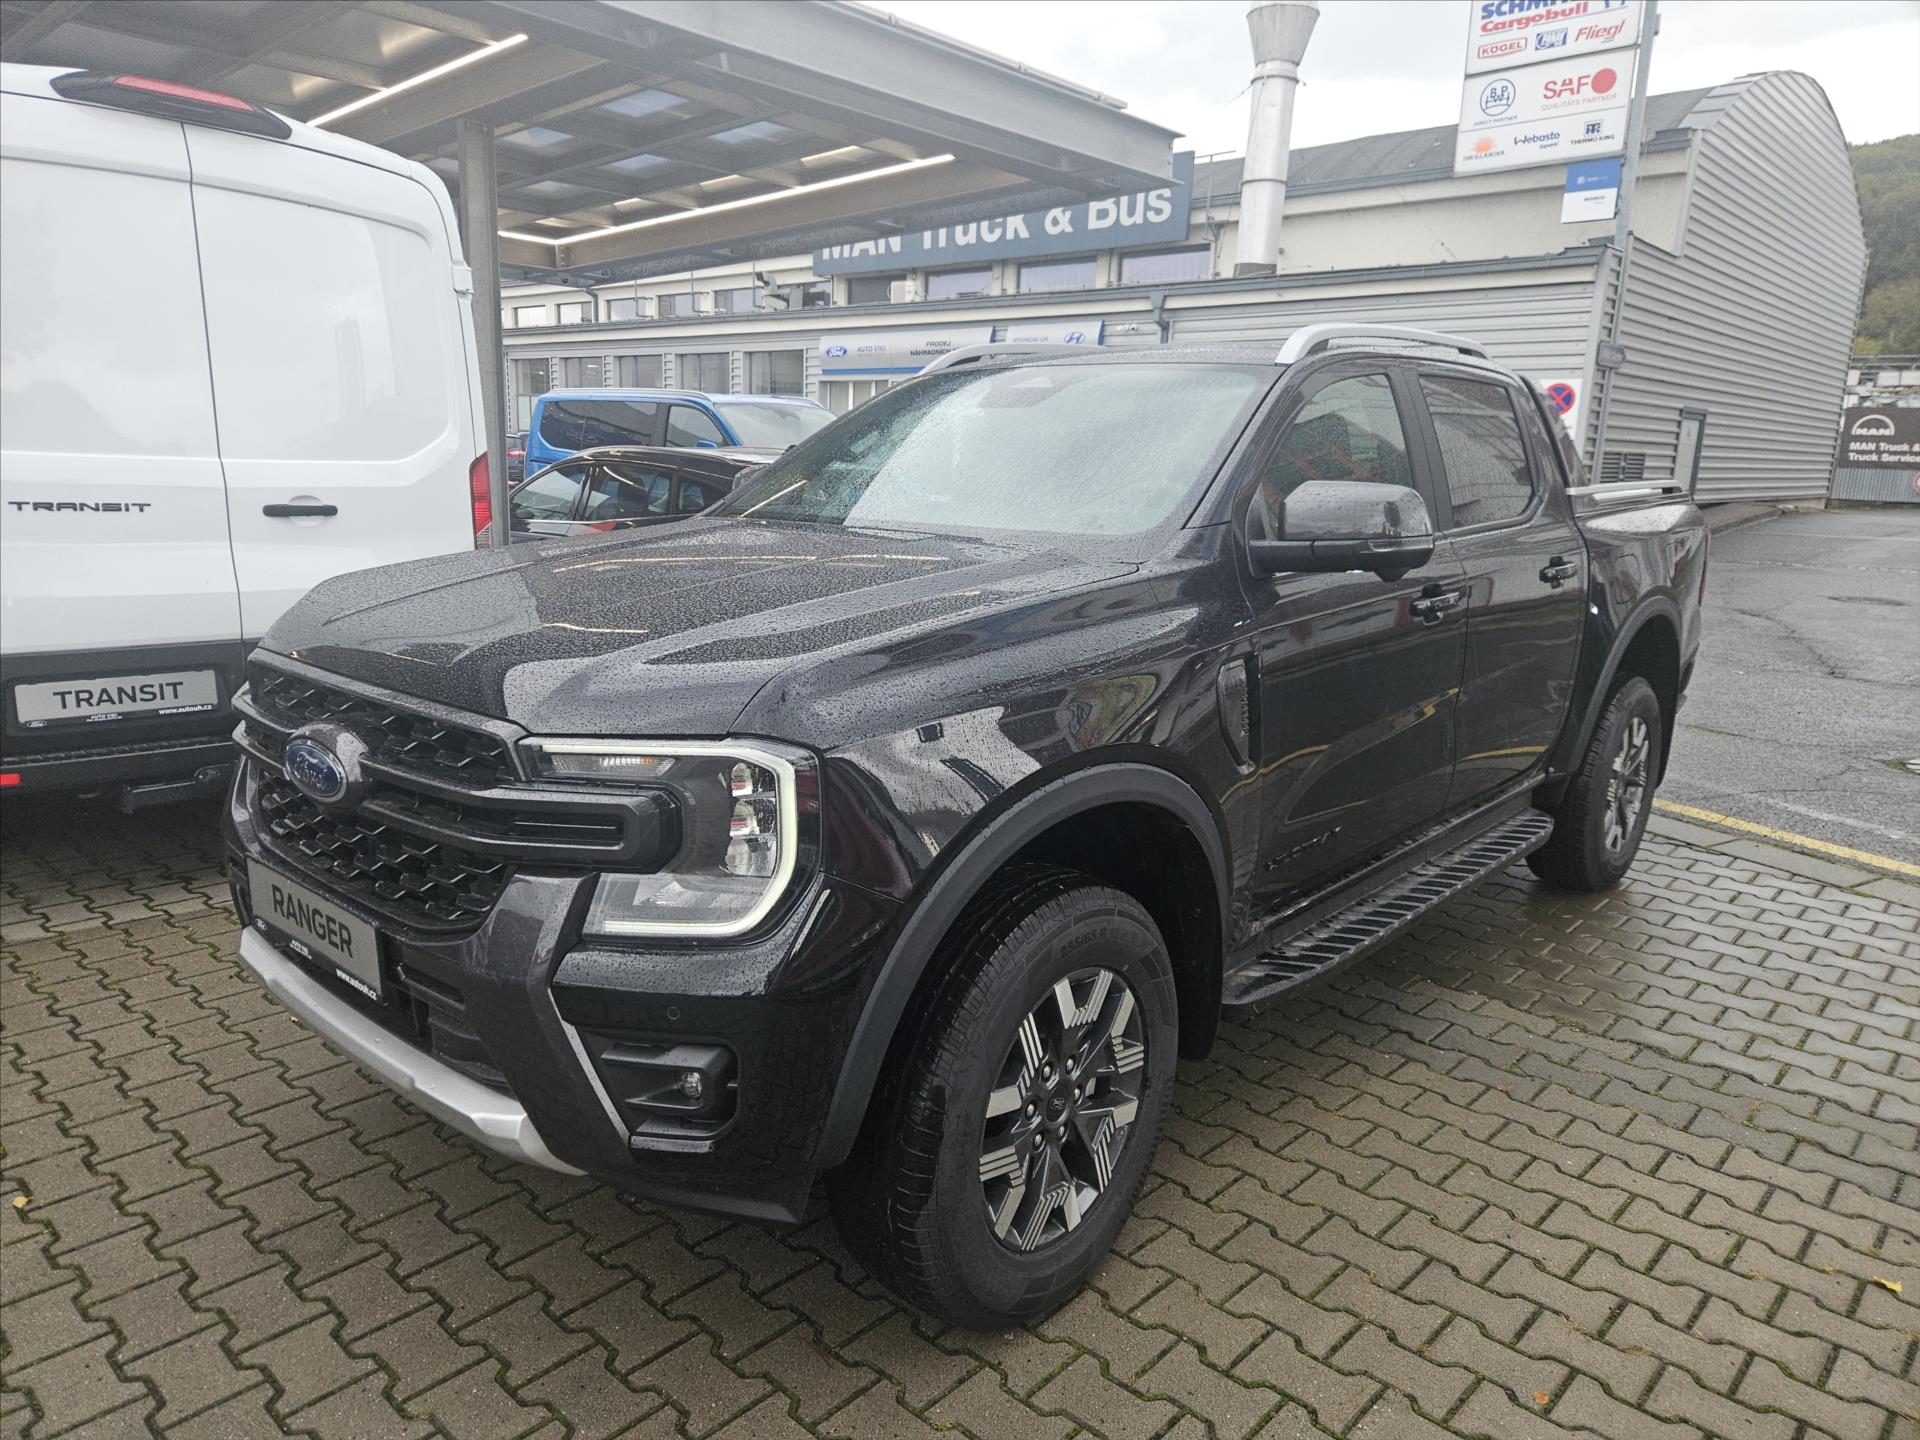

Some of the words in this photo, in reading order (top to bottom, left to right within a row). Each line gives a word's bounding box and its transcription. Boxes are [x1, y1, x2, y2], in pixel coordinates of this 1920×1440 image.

[1481, 1, 1589, 33] Cargobull
[1575, 19, 1626, 42] Fliegl
[1514, 131, 1560, 146] Webasto
[1044, 207, 1074, 236] &
[1087, 187, 1173, 231] Bus
[857, 345, 873, 353] AUTO
[926, 340, 952, 348] PRODEJ
[1850, 442, 1876, 451] MAN
[1879, 442, 1910, 452] Truck
[1848, 452, 1879, 462] Truck
[8, 501, 152, 513] TRANSIT
[53, 681, 184, 710] TRANSIT
[158, 704, 213, 716] www.autouh.cz
[271, 883, 353, 958] RANGER
